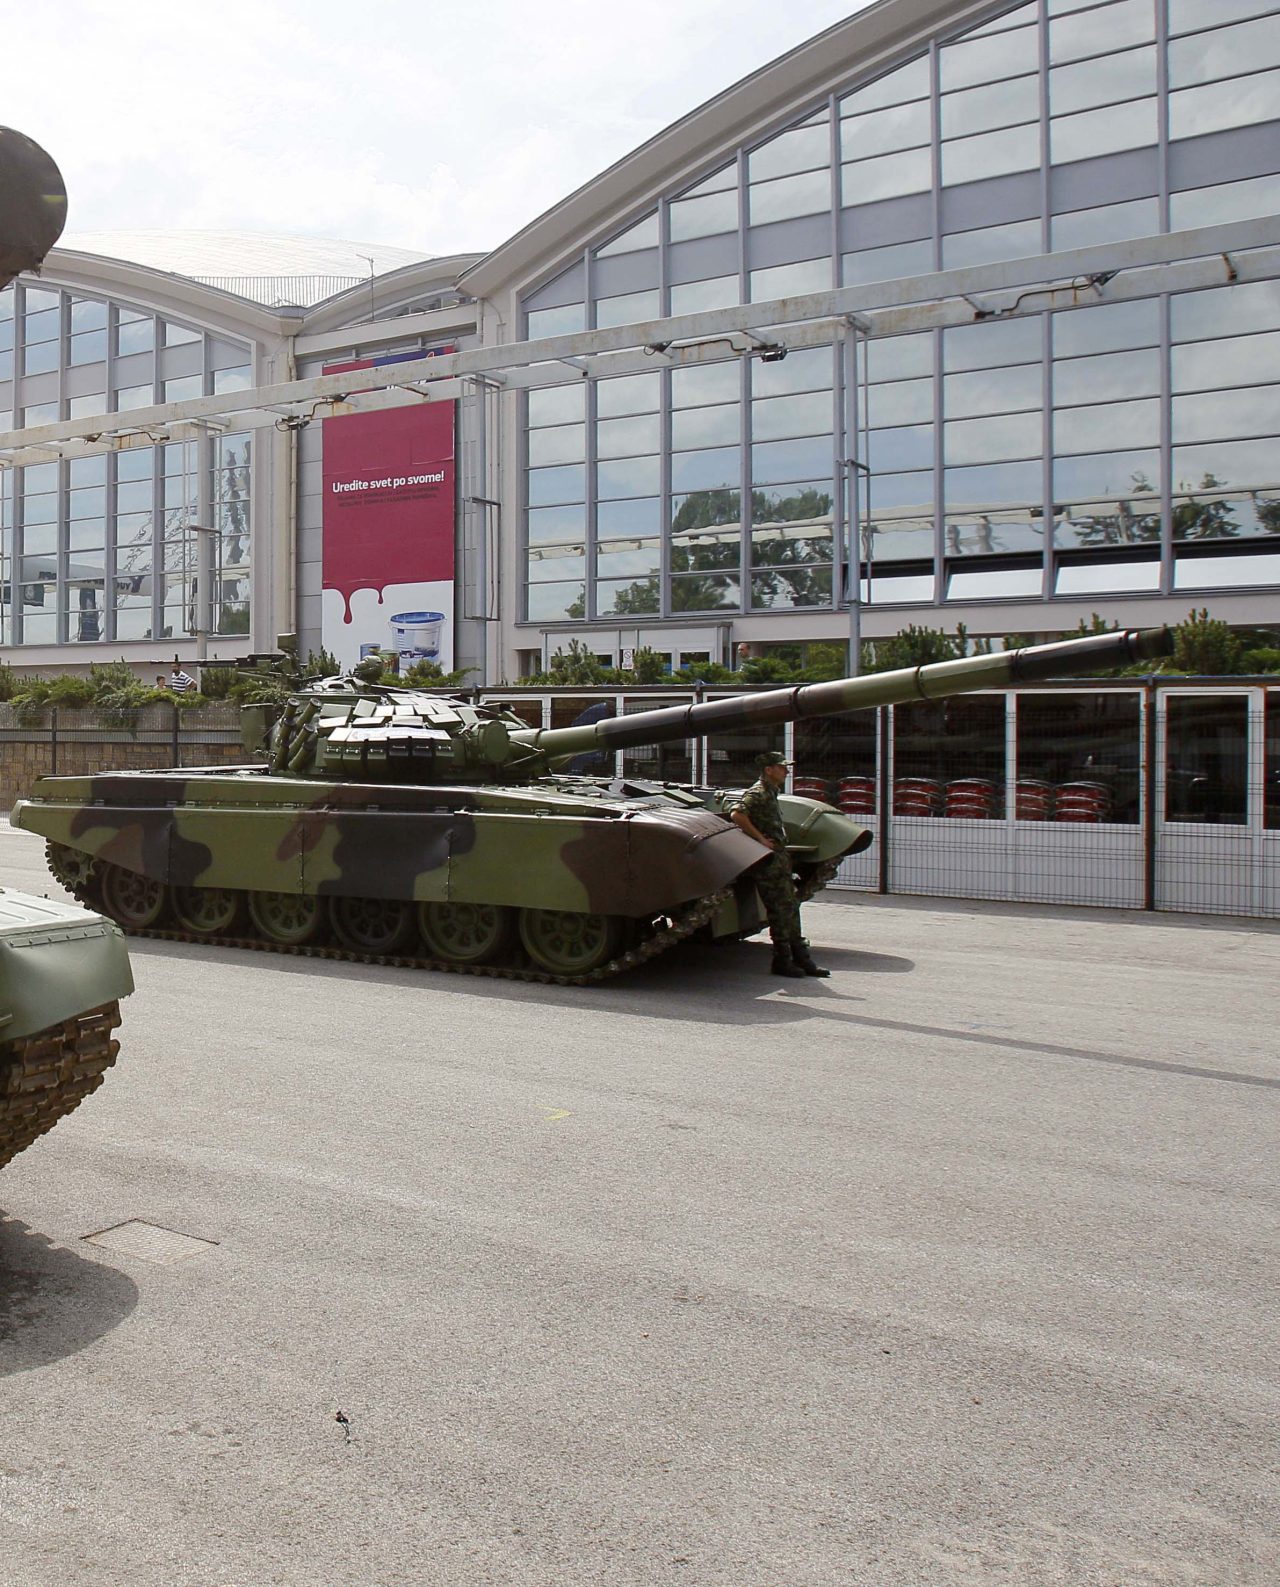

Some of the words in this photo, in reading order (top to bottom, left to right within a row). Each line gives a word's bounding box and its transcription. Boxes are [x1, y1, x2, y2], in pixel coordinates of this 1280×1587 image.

[332, 480, 369, 492] Uredite
[369, 477, 393, 489] svet
[393, 477, 406, 489] po
[407, 470, 445, 485] svome!
